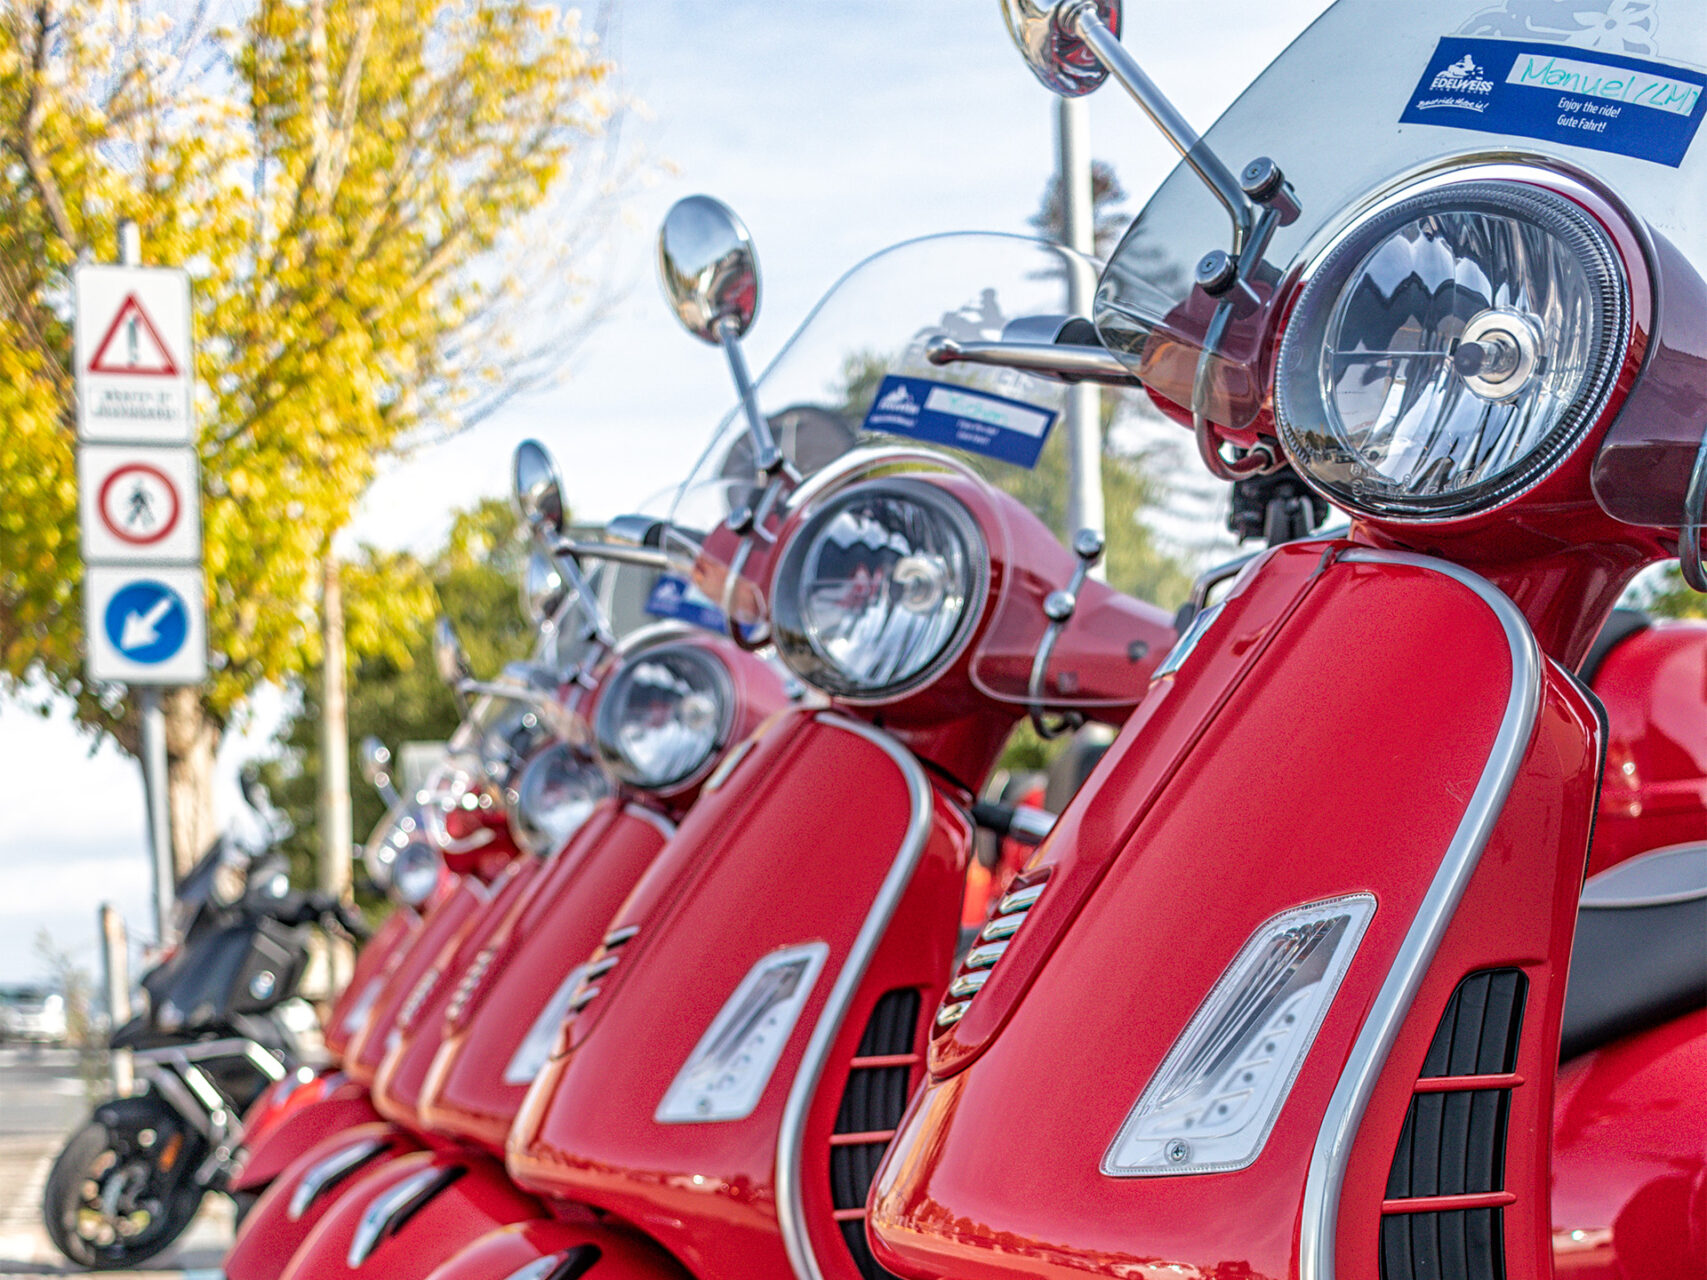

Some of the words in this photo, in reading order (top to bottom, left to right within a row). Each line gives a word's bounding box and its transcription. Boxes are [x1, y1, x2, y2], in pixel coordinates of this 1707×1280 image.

[1431, 77, 1494, 92] EDELWEISS
[1520, 57, 1636, 101] Manuel
[1557, 97, 1582, 113] Enjoy
[1582, 101, 1599, 114] the
[1598, 104, 1622, 118] ride!
[1556, 114, 1578, 128] Gute
[1577, 117, 1607, 133] Fahrt!
